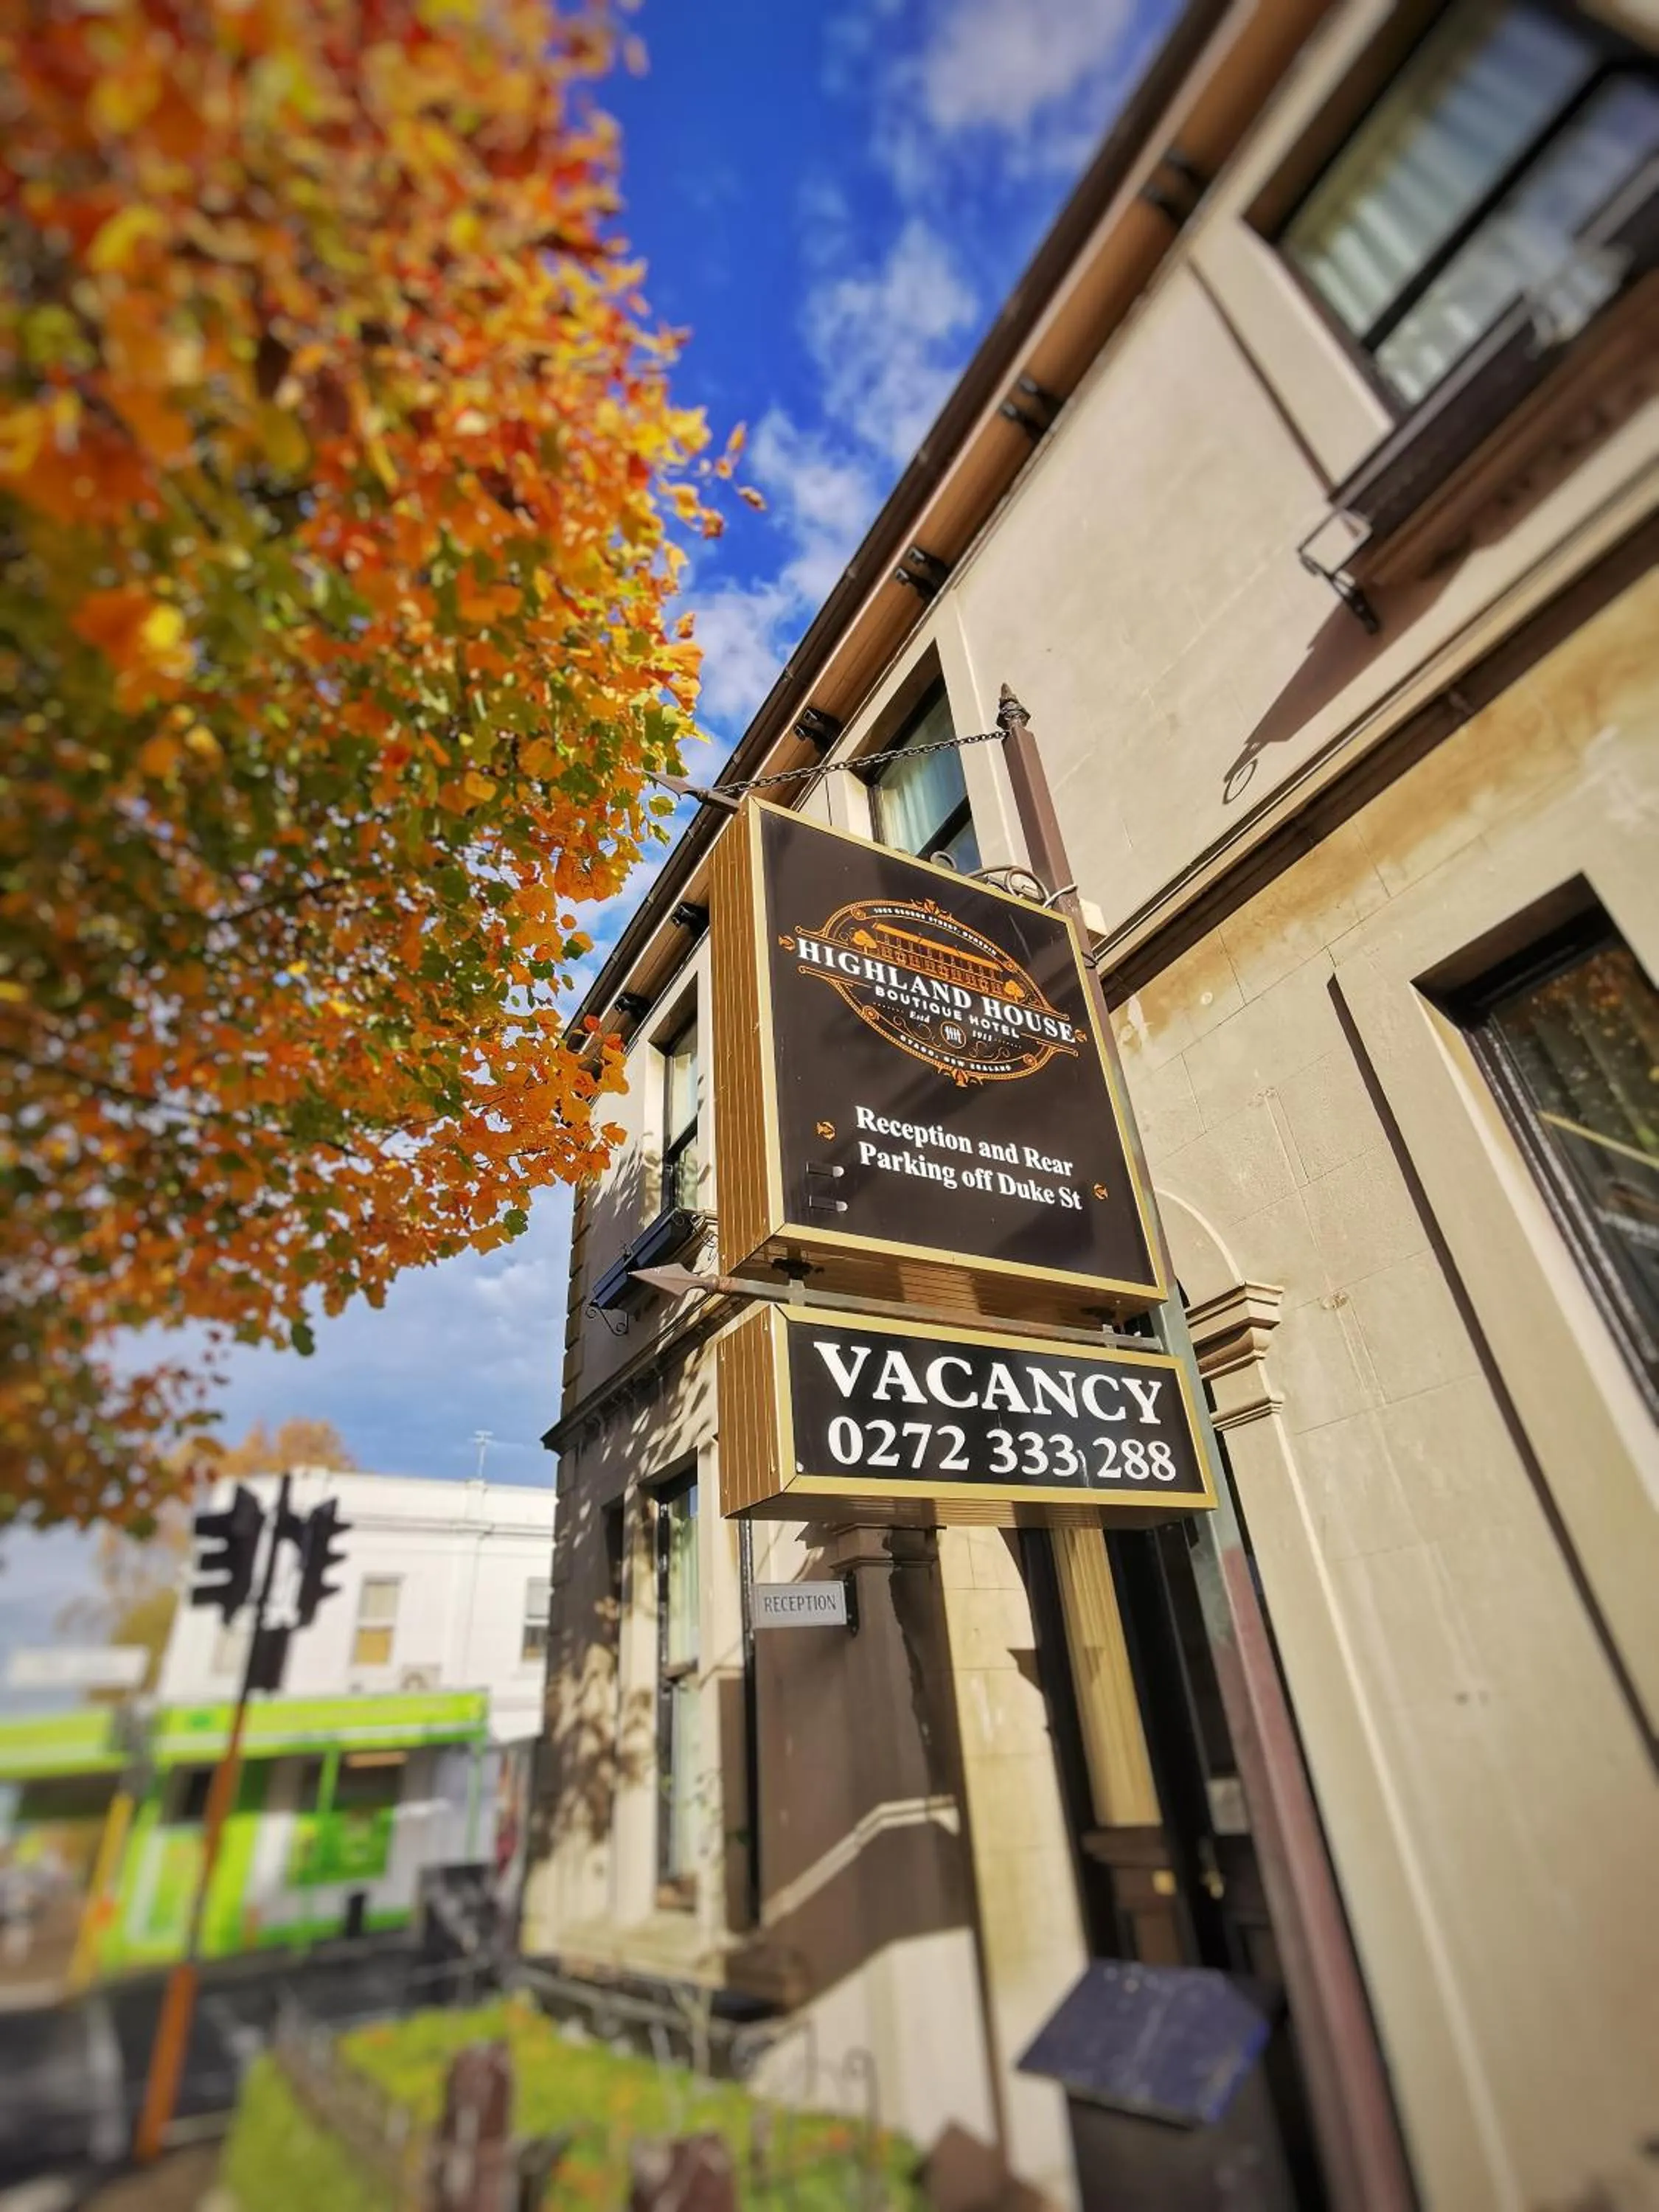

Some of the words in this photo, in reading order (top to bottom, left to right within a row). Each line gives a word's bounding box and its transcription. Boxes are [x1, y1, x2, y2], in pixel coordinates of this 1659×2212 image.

[796, 937, 972, 1009] HIGHLAND
[981, 996, 1076, 1043] HOUSE
[874, 985, 962, 1021] BOUTIQUE
[969, 1014, 1020, 1039] HOTEL
[855, 1106, 973, 1155] Reception
[978, 1140, 1020, 1164] and
[1022, 1147, 1073, 1178] Rear
[858, 1141, 959, 1190] Parking
[962, 1168, 993, 1192] off
[997, 1172, 1056, 1206] Duke
[1059, 1186, 1083, 1211] St
[813, 1341, 1163, 1425] VACANCY
[827, 1416, 970, 1471] 0272
[986, 1428, 1079, 1477] 333
[1092, 1436, 1177, 1482] 288
[764, 1594, 837, 1613] RECEPTION
